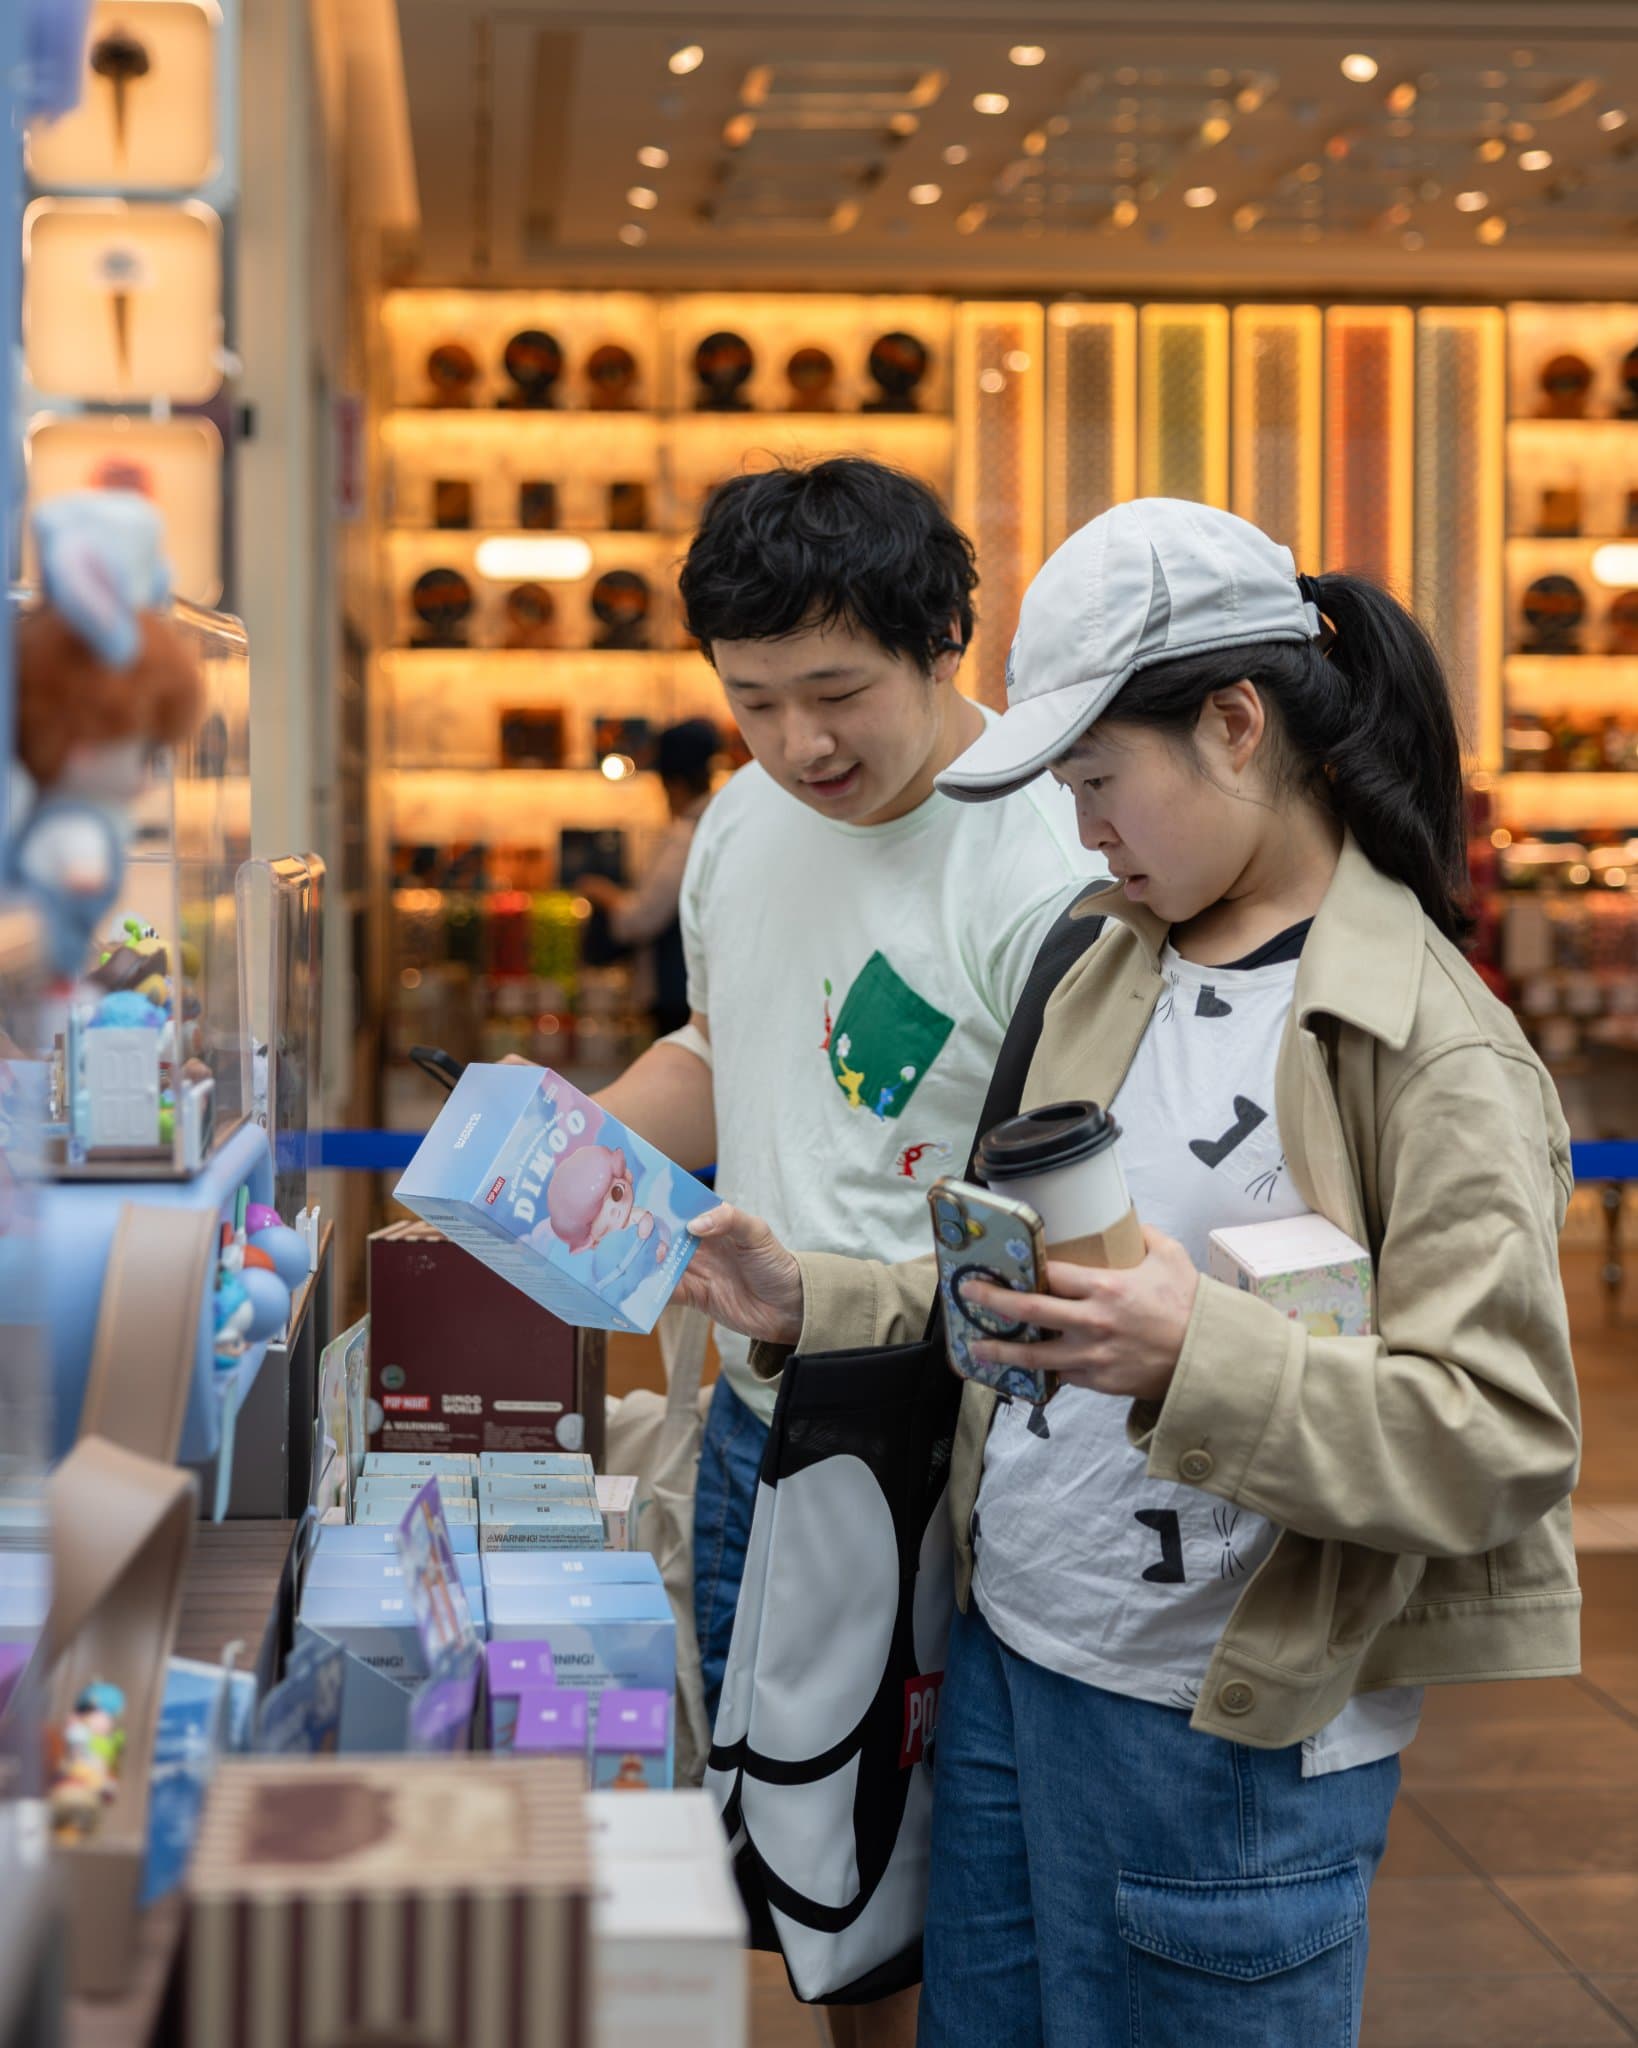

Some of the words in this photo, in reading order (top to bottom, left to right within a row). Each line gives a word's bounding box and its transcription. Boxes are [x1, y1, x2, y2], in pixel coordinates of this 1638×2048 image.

[514, 1109, 586, 1224] DIMOO
[492, 1176, 505, 1194] MART
[383, 1395, 401, 1410] POP
[402, 1396, 428, 1411] MART
[442, 1403, 483, 1415] WORLD
[495, 1534, 538, 1544] WARNING!
